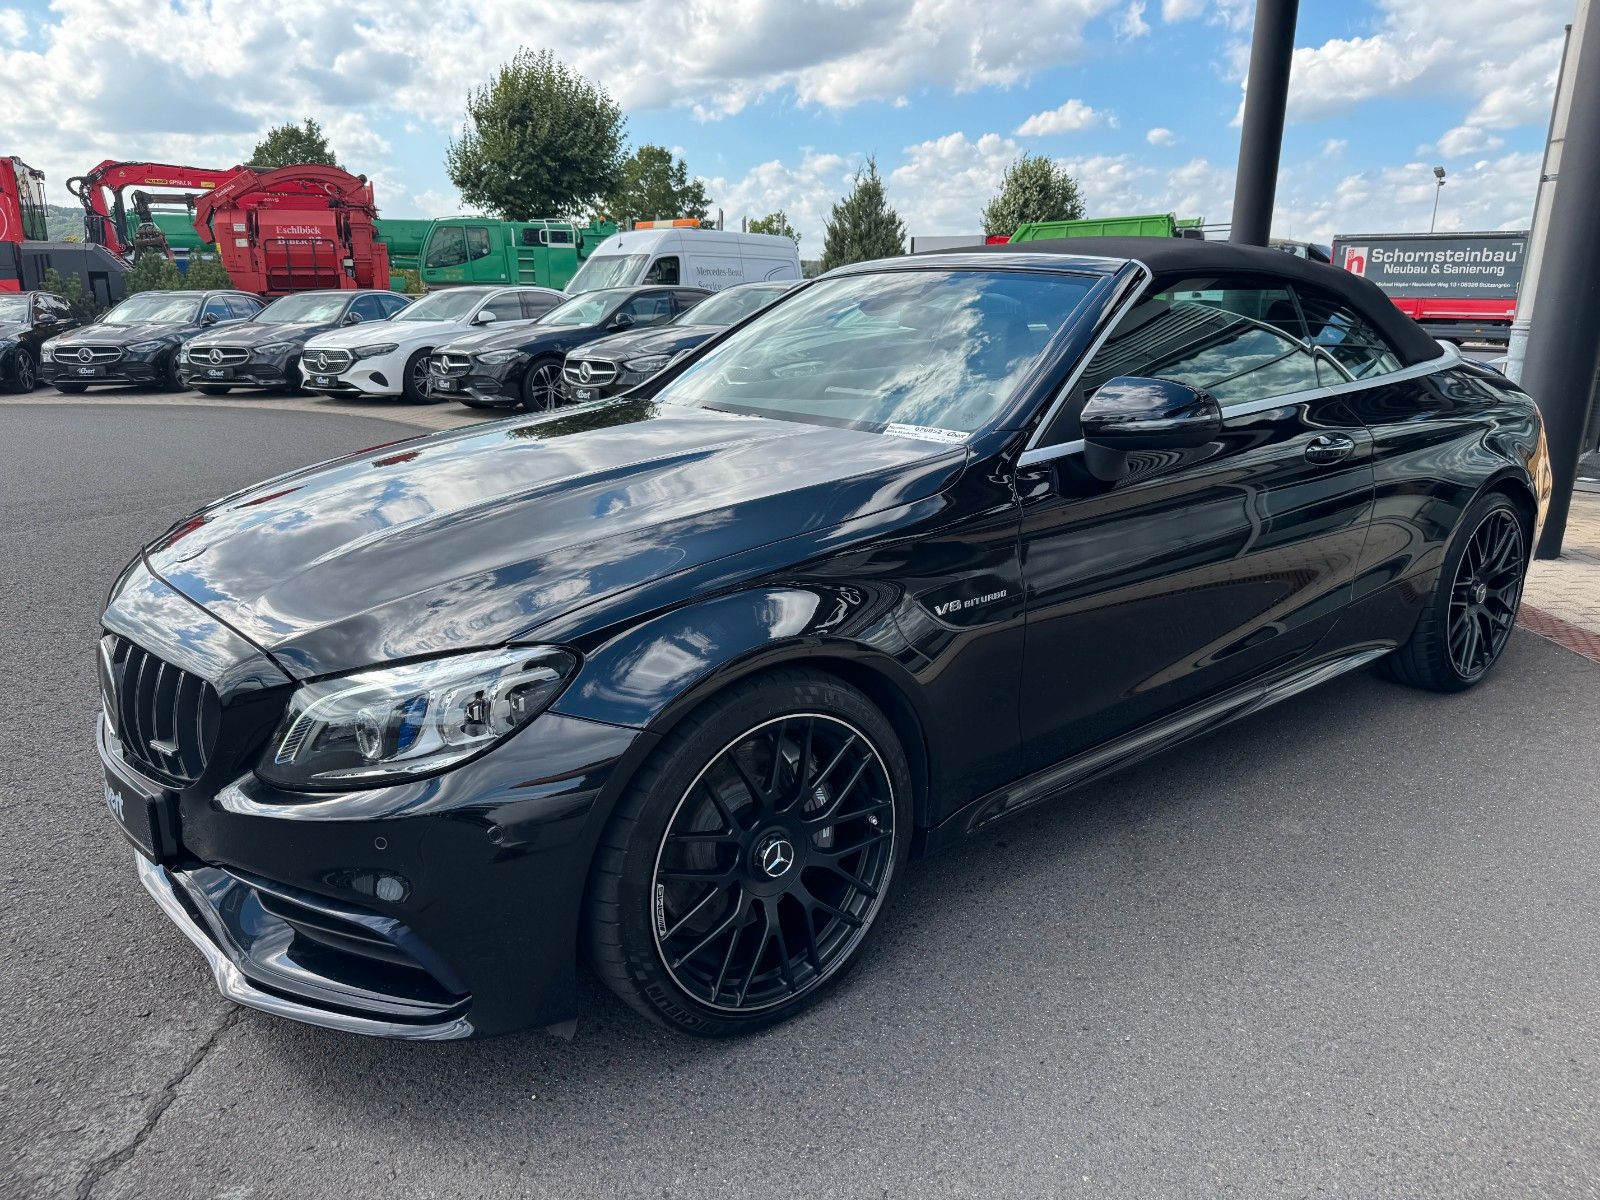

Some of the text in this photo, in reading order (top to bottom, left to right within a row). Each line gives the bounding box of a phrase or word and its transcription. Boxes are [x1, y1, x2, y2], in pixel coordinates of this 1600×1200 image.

[276, 225, 322, 235] Eschlböck
[1371, 248, 1517, 263] Schornsteinbau
[1383, 264, 1505, 277] Neubau & Sanierung
[934, 589, 1007, 616] V8 BITURBO
